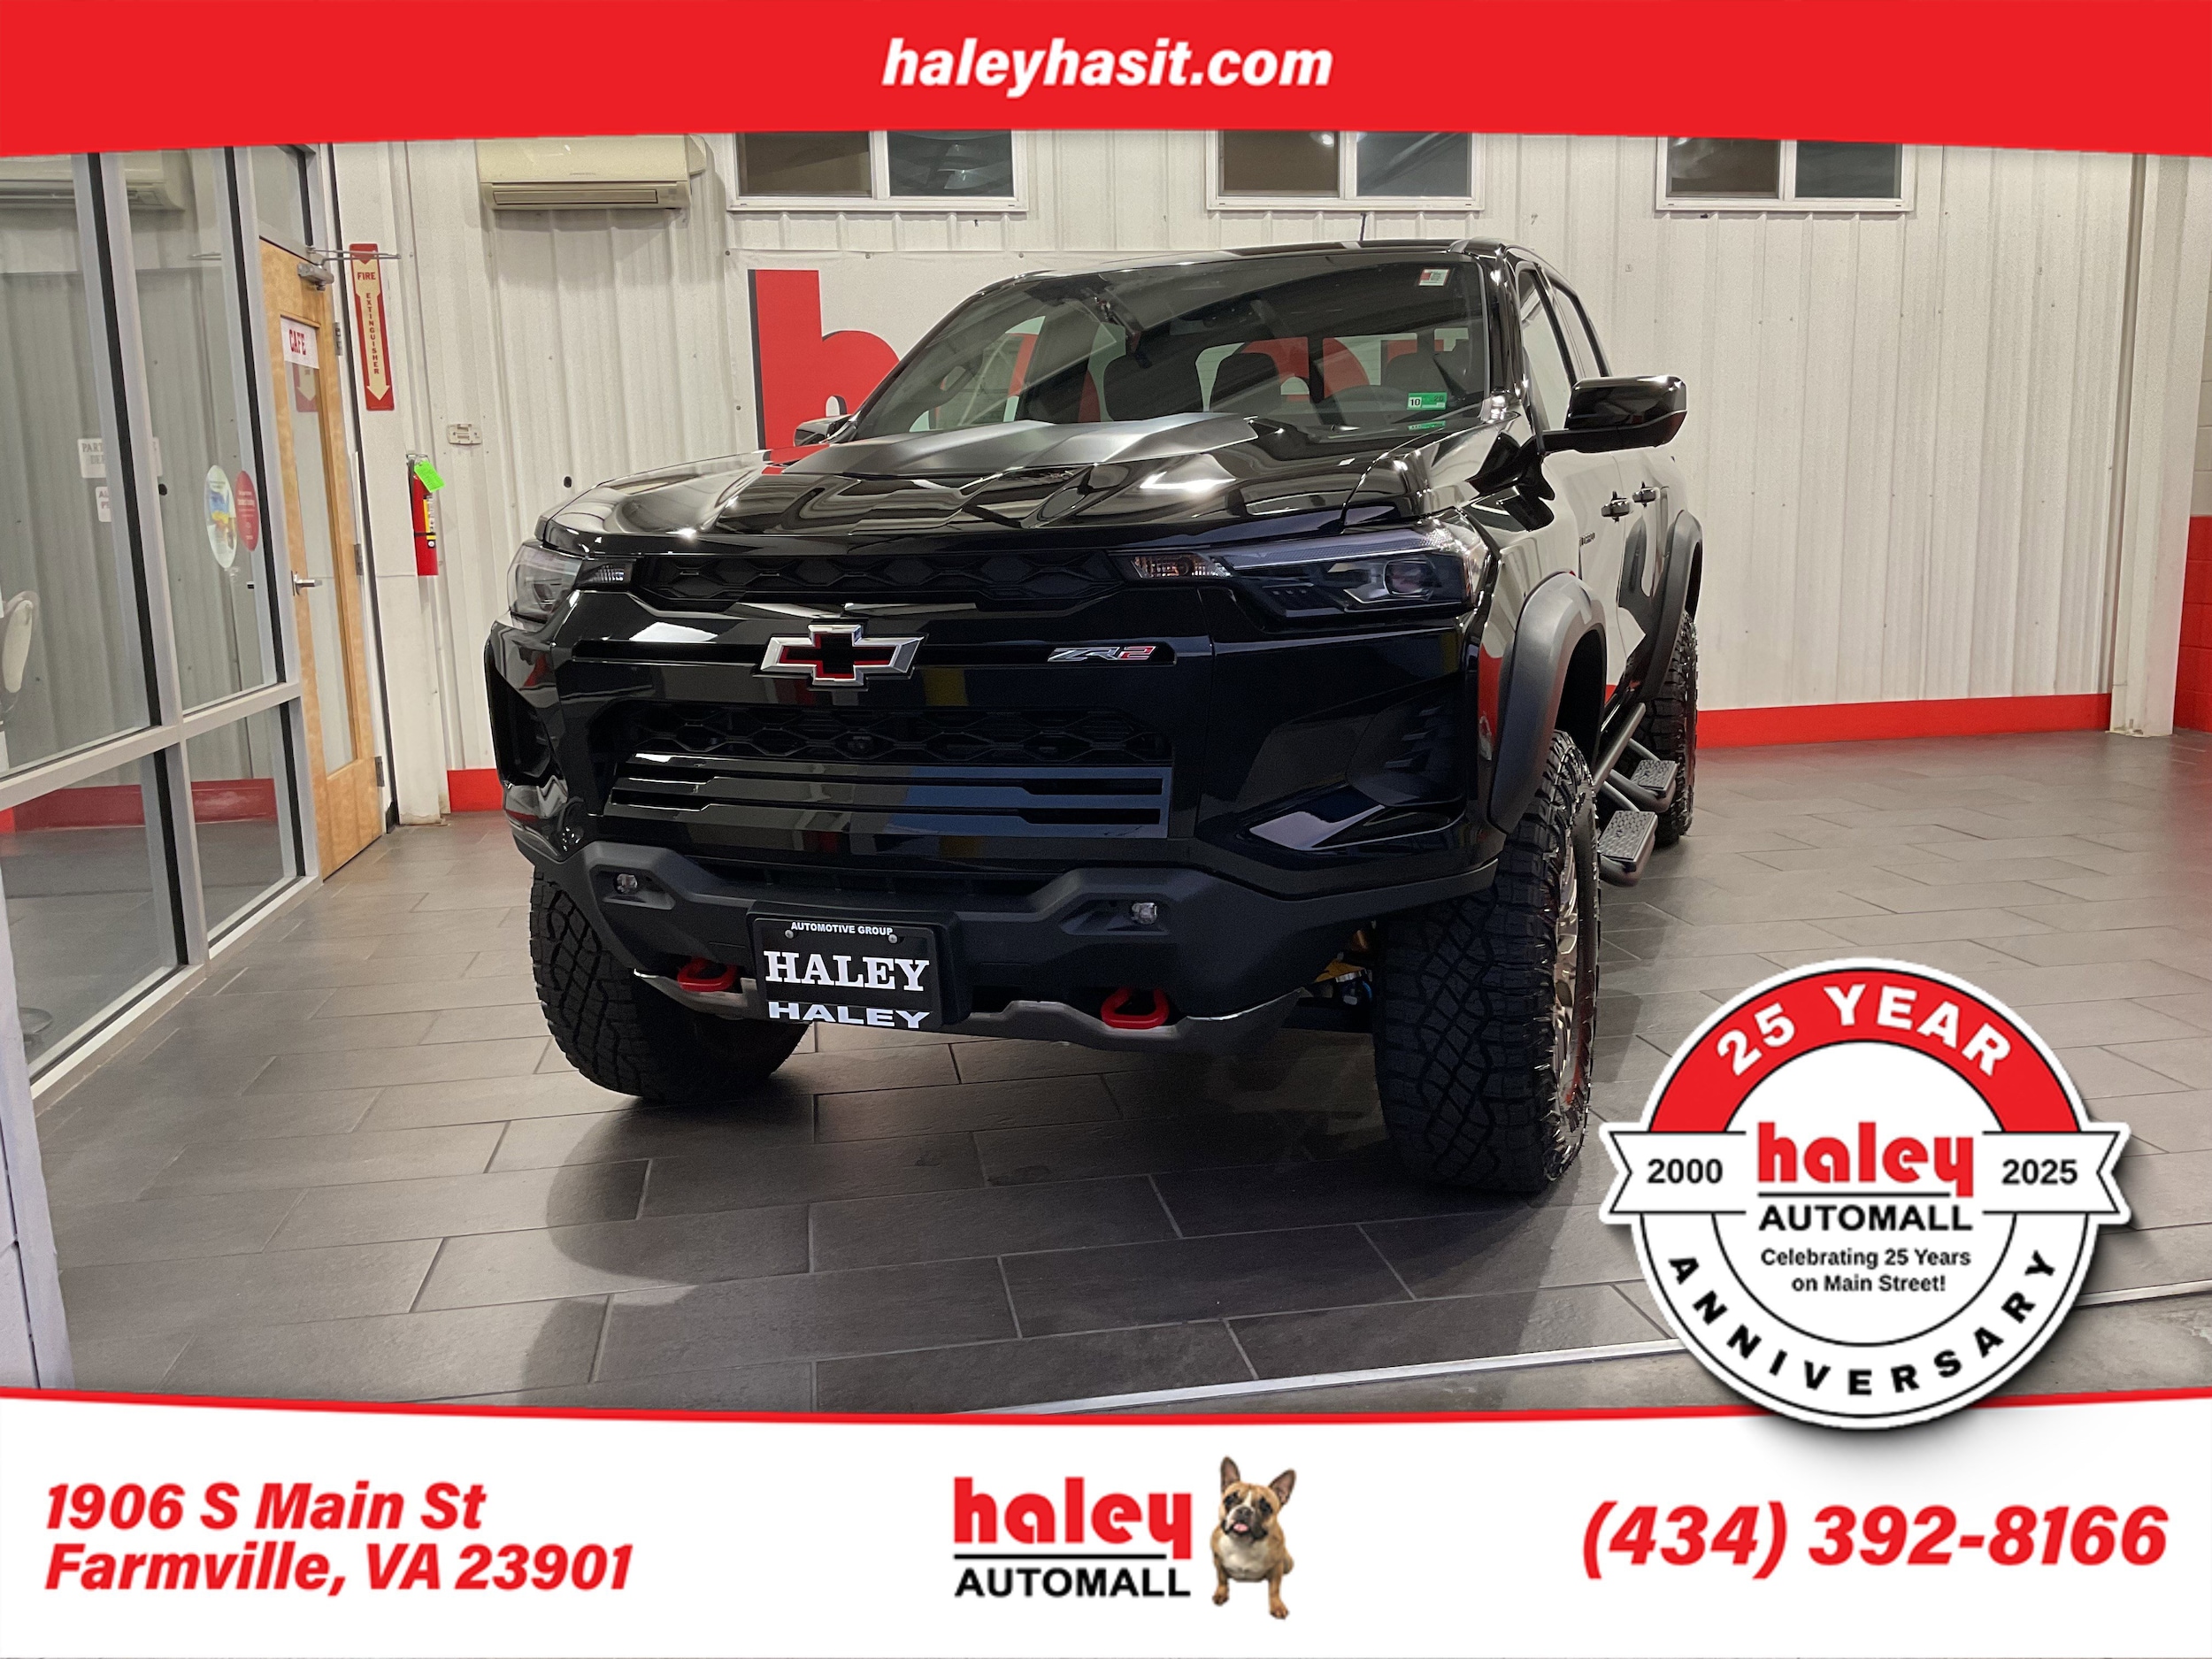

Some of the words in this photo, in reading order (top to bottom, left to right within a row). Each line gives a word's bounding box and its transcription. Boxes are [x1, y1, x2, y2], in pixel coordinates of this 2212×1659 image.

[357, 272, 376, 280] FIRE
[288, 328, 307, 356] CAFE
[365, 292, 380, 375] EXTINGUISHER
[1048, 645, 1156, 663] ZR2
[790, 921, 856, 934] AUTOMOTIVE
[857, 926, 894, 936] GROUP
[764, 950, 930, 992] HALEY
[768, 1001, 931, 1030] HALEY
